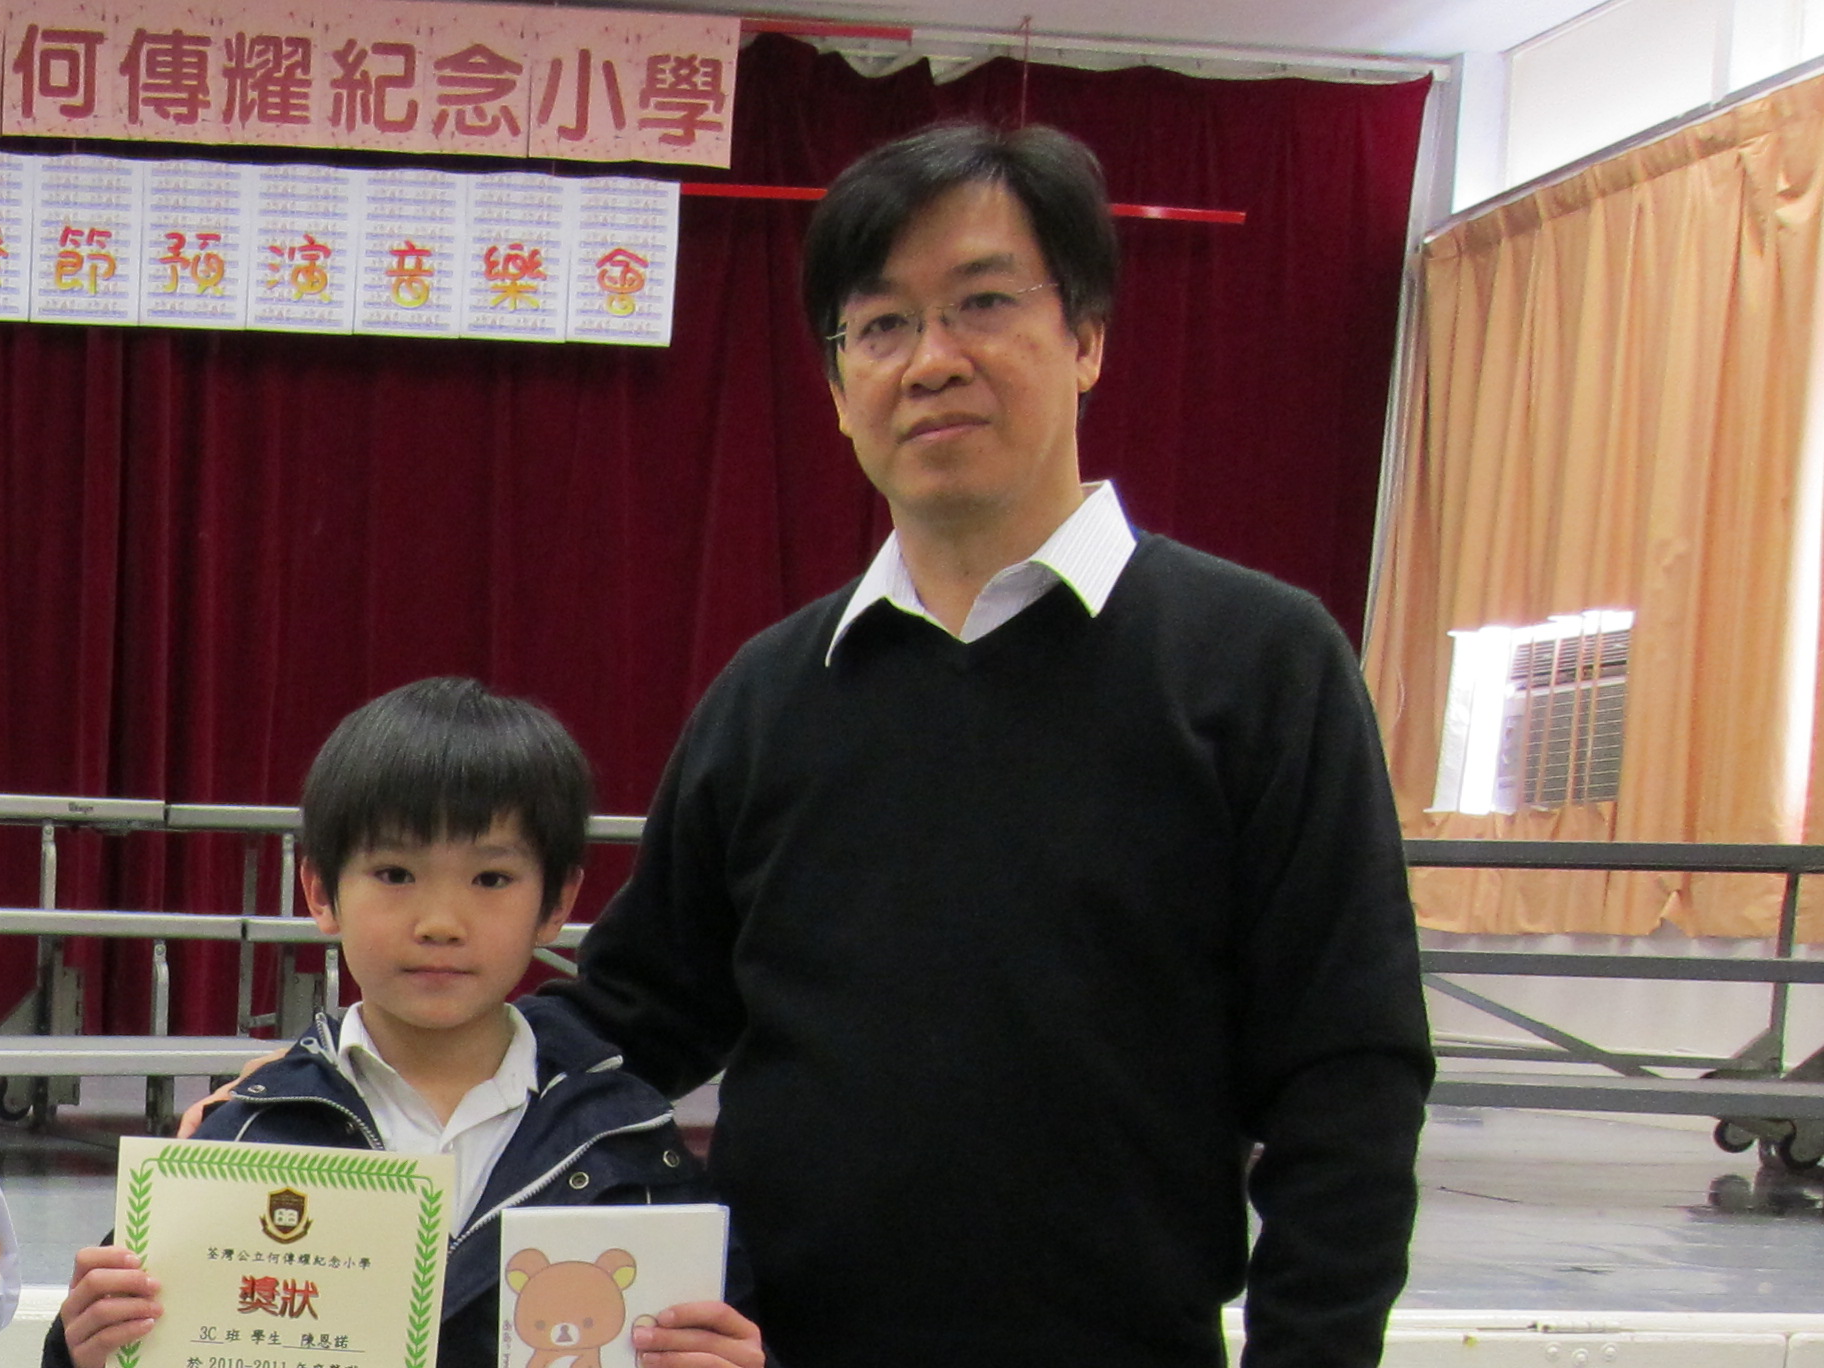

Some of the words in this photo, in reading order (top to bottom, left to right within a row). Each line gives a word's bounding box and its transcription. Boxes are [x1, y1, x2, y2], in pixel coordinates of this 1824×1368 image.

[207, 1247, 371, 1270] 荃灣公立何傳耀紀念小學
[237, 1274, 319, 1320] 獎狀
[199, 1326, 218, 1341] 3C
[225, 1329, 241, 1342] 班
[250, 1329, 282, 1345] 學生
